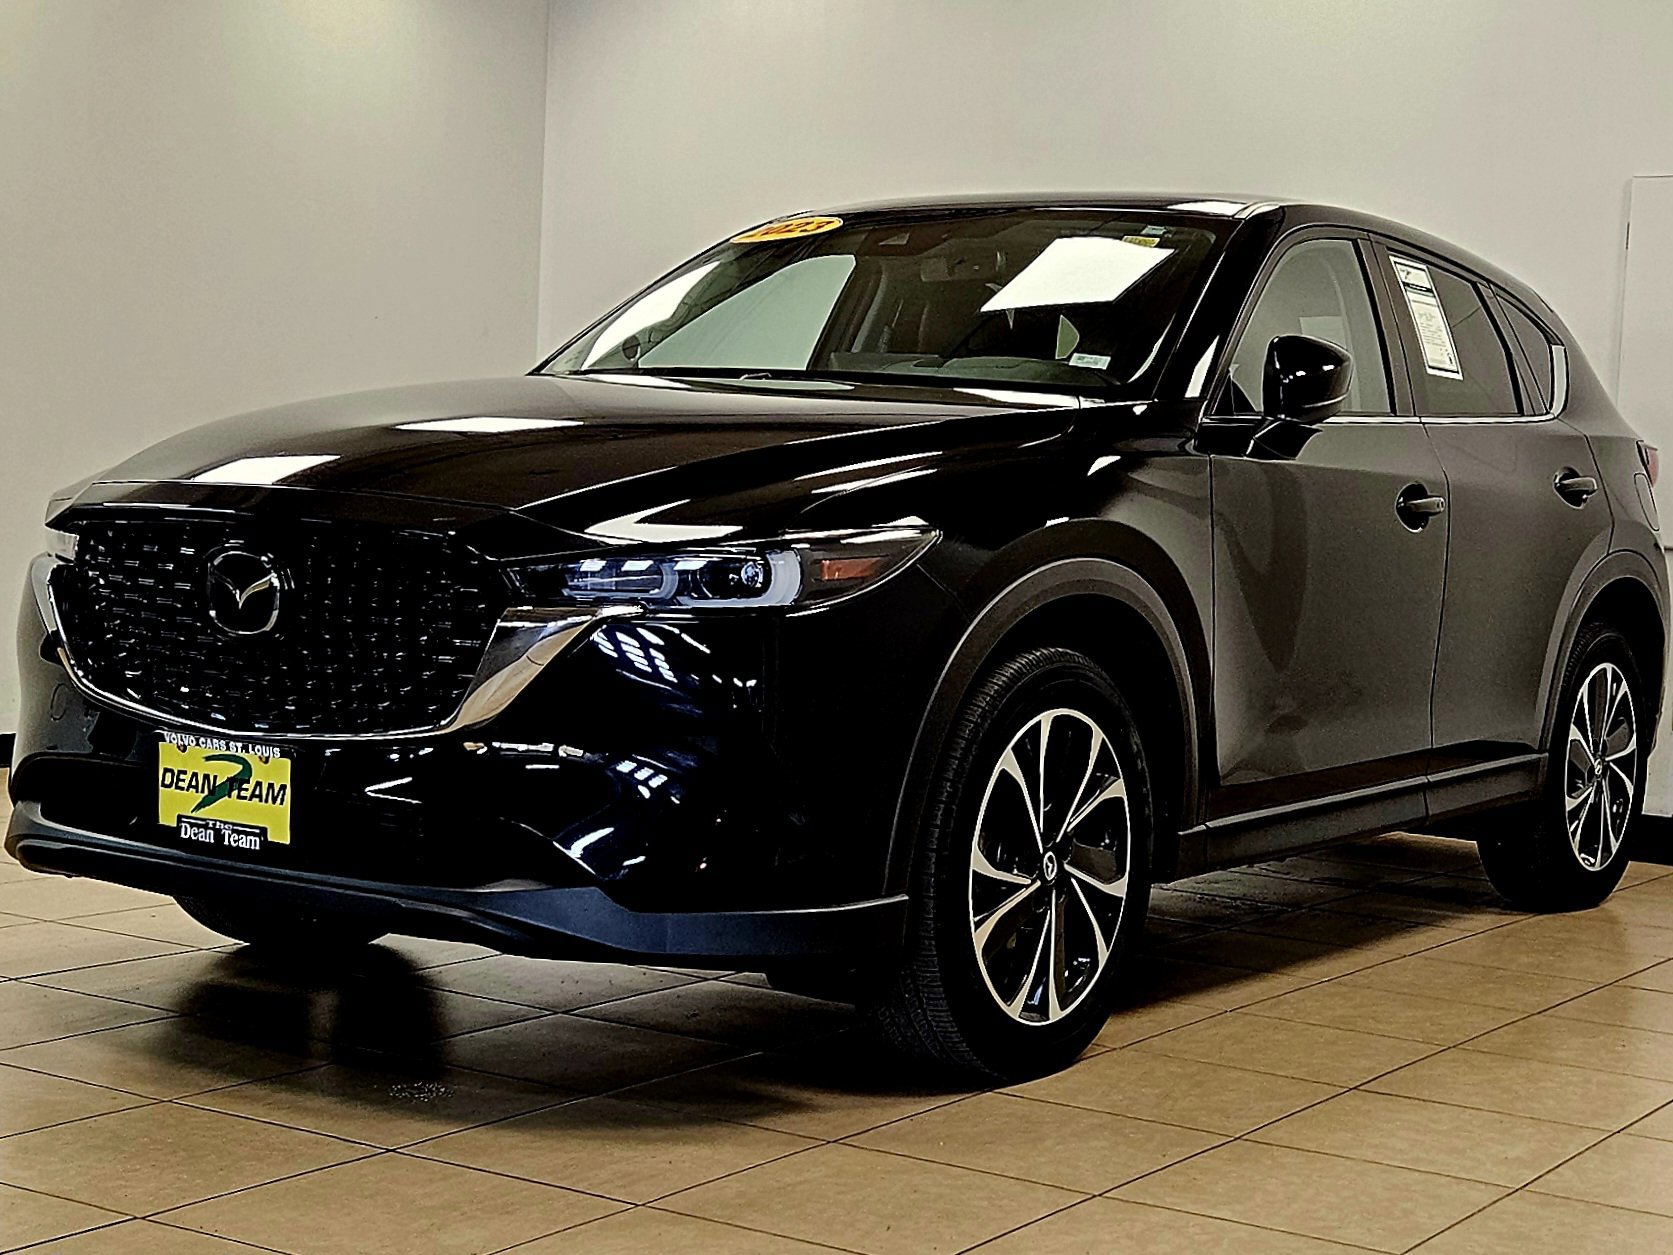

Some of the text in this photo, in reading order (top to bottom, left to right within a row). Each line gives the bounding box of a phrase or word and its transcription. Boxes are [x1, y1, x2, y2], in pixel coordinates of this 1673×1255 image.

[163, 732, 281, 758] VOLVO CARS ST. LOUIS
[161, 767, 288, 806] DEAN TEAM
[180, 823, 260, 850] Dean Team
[206, 820, 232, 830] The
